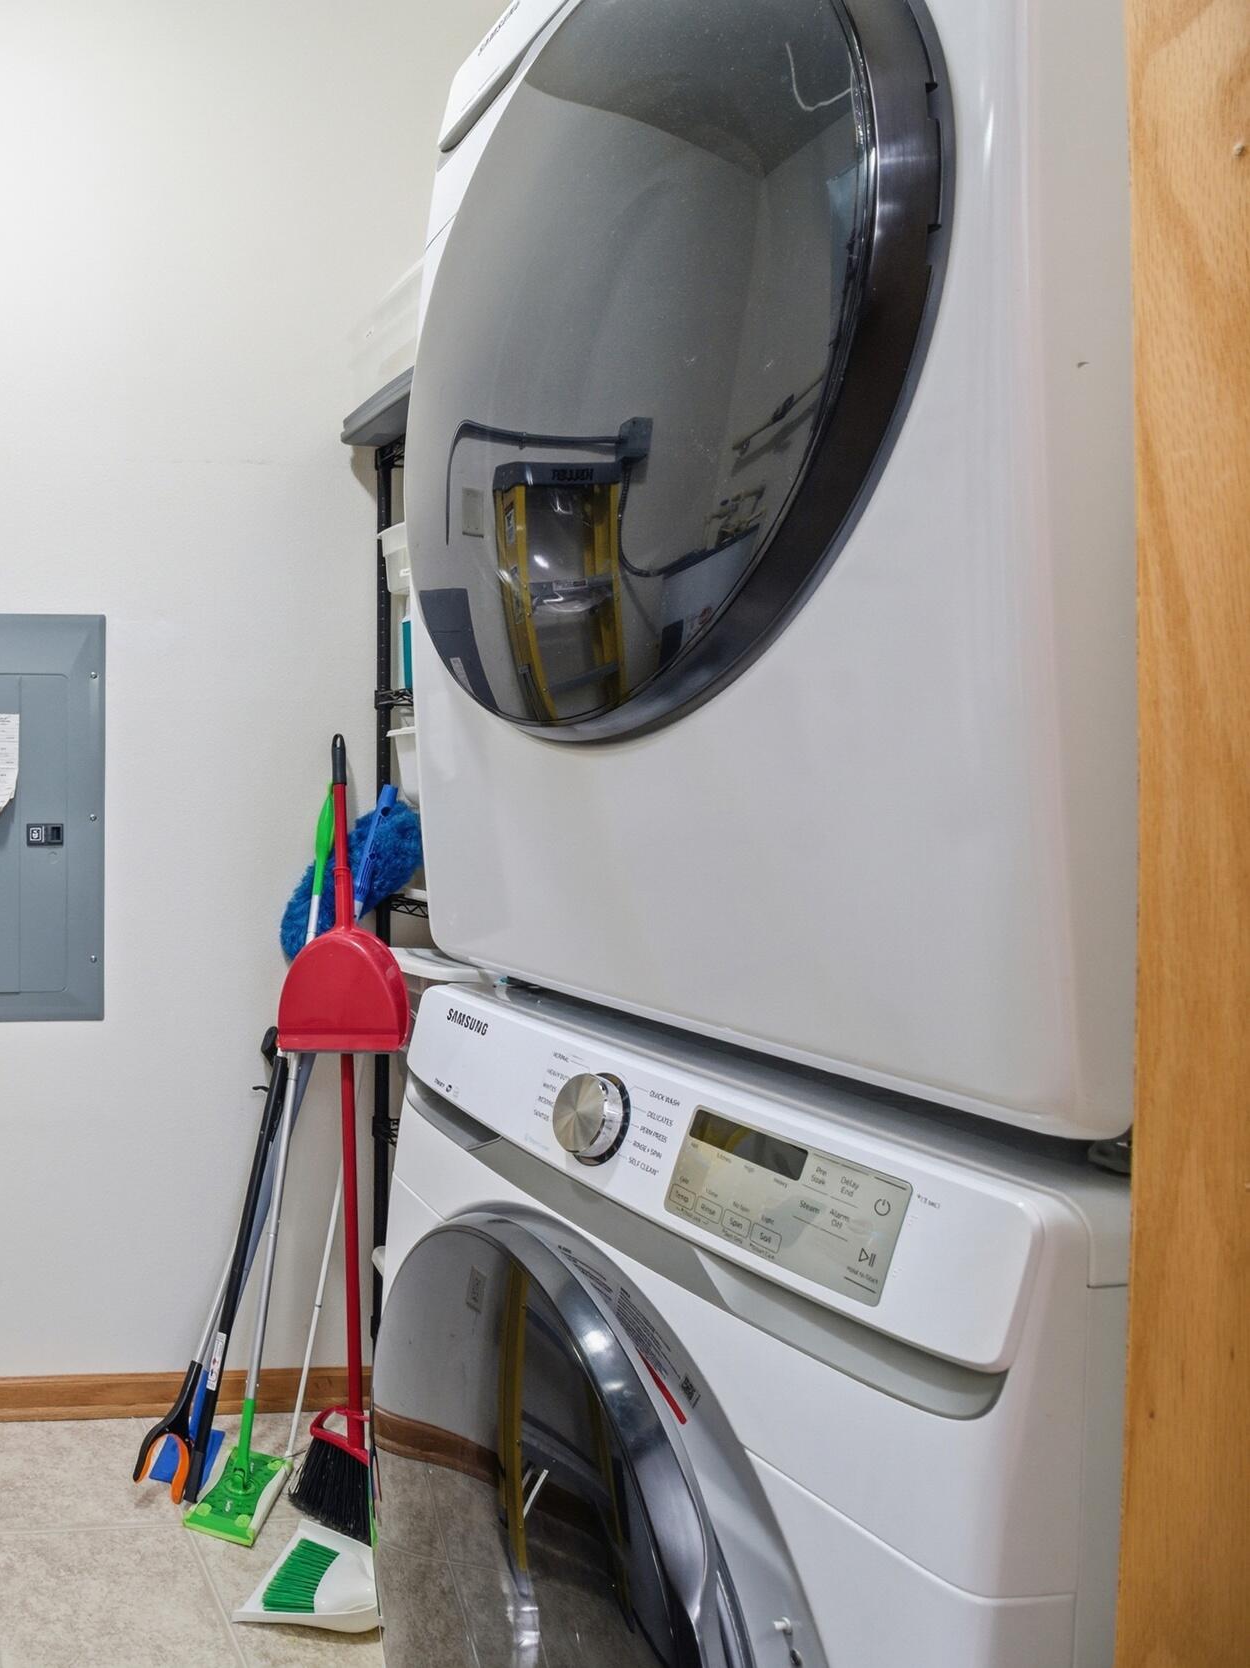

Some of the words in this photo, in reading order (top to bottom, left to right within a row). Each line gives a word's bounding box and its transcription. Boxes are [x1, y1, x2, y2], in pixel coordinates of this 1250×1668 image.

[446, 1008, 489, 1036] SAMSUNG
[646, 1110, 674, 1128] DELICATES
[840, 1175, 860, 1191] Delay
[840, 1186, 855, 1198] End
[799, 1199, 821, 1215] Steam
[829, 1207, 850, 1223] Alarm
[729, 1217, 743, 1230] Spin
